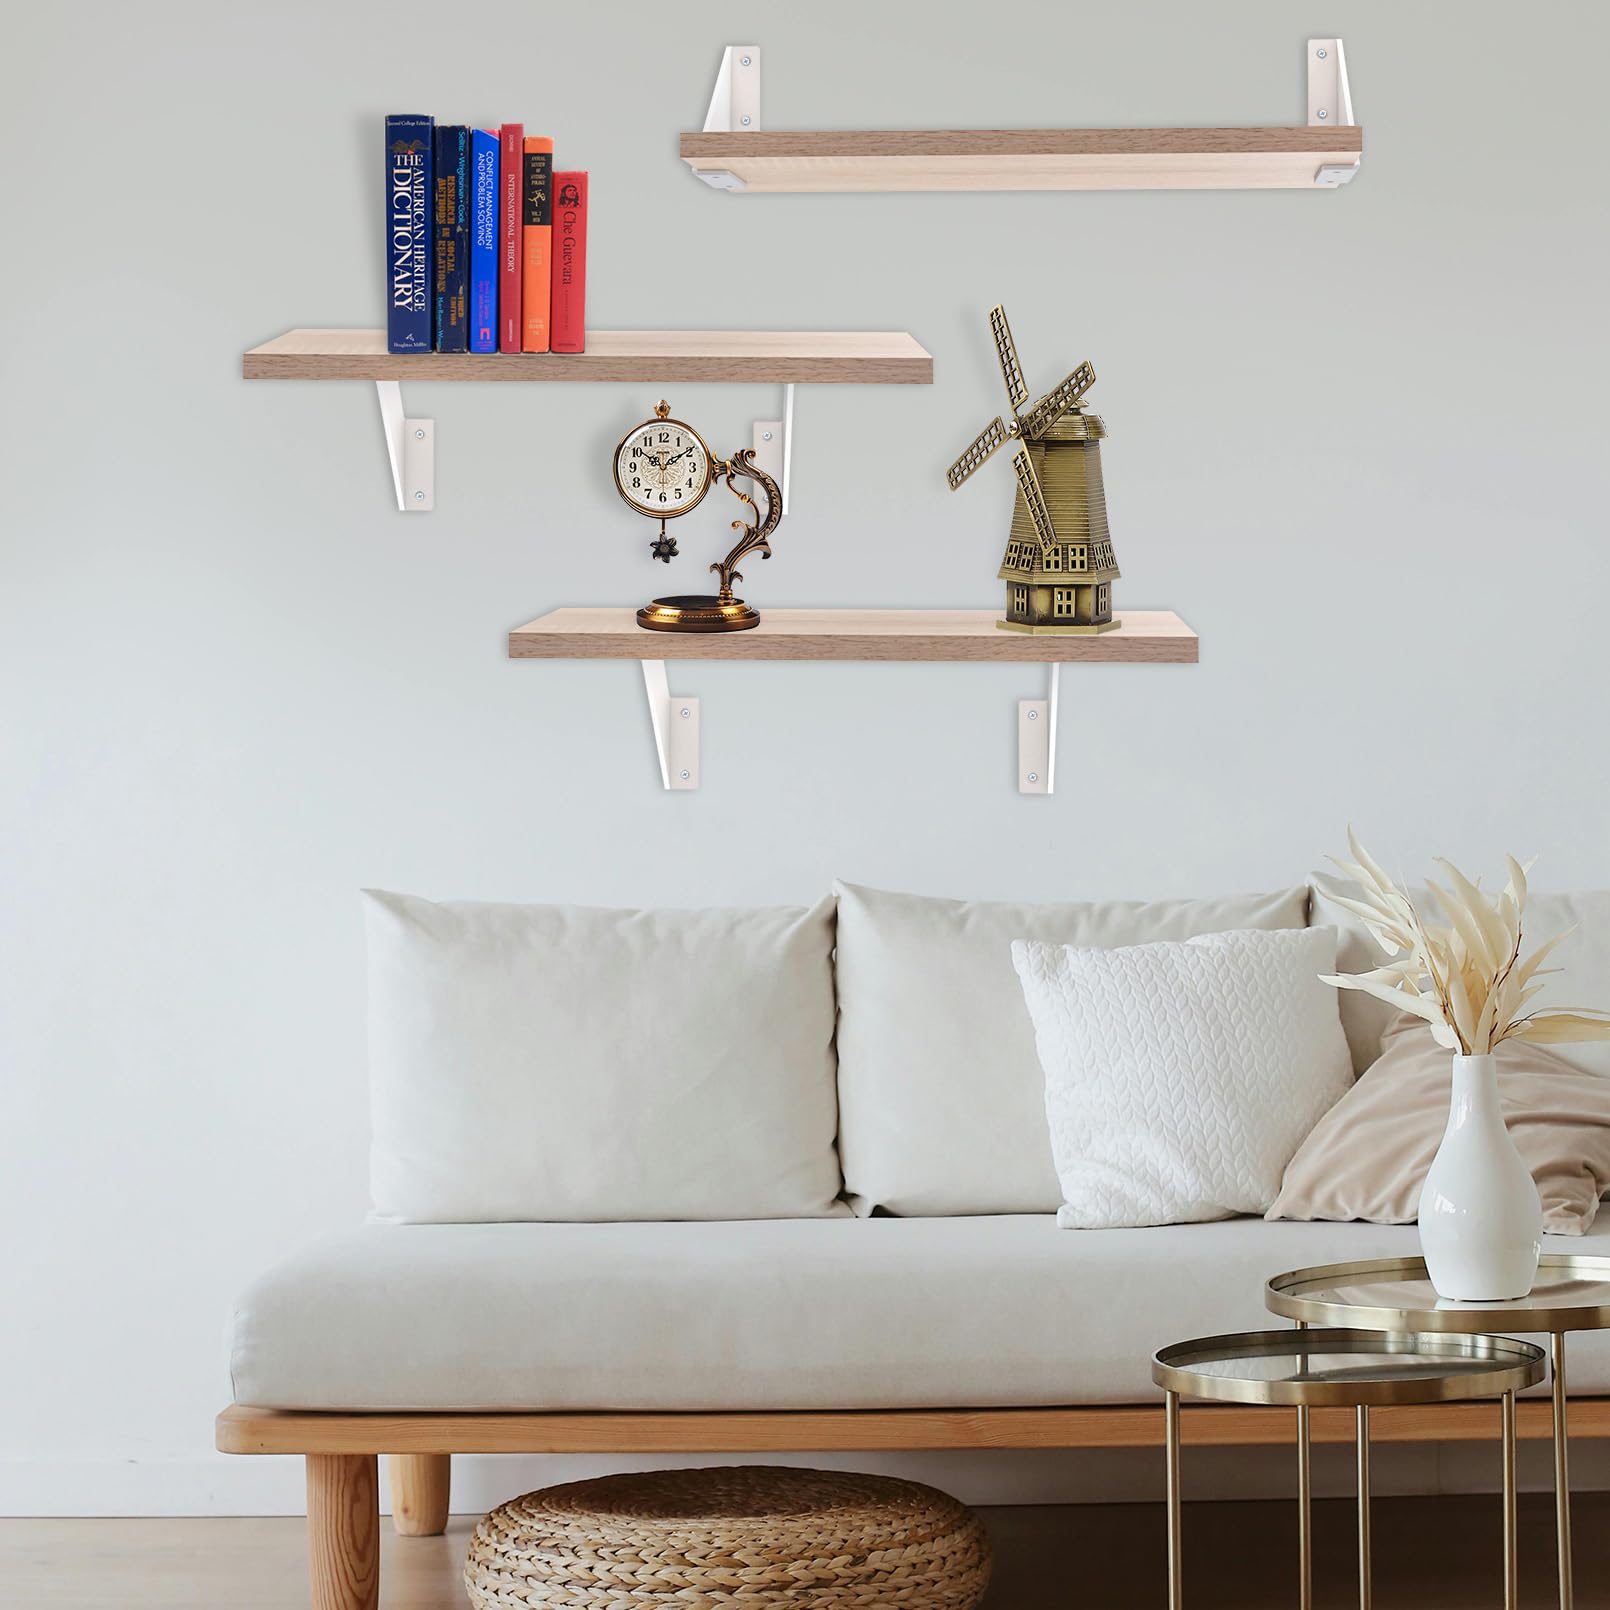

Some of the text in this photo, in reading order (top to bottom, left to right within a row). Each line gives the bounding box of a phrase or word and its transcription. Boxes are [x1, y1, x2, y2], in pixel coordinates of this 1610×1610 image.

[393, 154, 424, 166] THE
[456, 157, 466, 199] Wrightsman
[438, 178, 447, 224] METHODS
[447, 175, 456, 224] RESEARCH
[477, 152, 486, 246] AND PROBLEM SOLVING
[485, 150, 494, 250] CONFLICT MANAGEMENT
[393, 167, 413, 312] DICTIONARY
[413, 167, 426, 312] AMERICAN HERITAGE
[562, 211, 577, 285] Che Guevara
[447, 240, 455, 273] SOCIAL
[438, 240, 446, 293] RELATIONS
[643, 436, 652, 447] 11
[659, 432, 669, 443] 12
[676, 437, 680, 447] 1
[632, 447, 642, 457] 10
[686, 447, 693, 457] 2
[629, 462, 637, 473] 9
[689, 462, 696, 473] 3
[632, 477, 640, 488] 8
[685, 477, 692, 488] 4
[644, 488, 652, 499] 7
[659, 492, 667, 503] 6
[674, 488, 682, 499] 5
